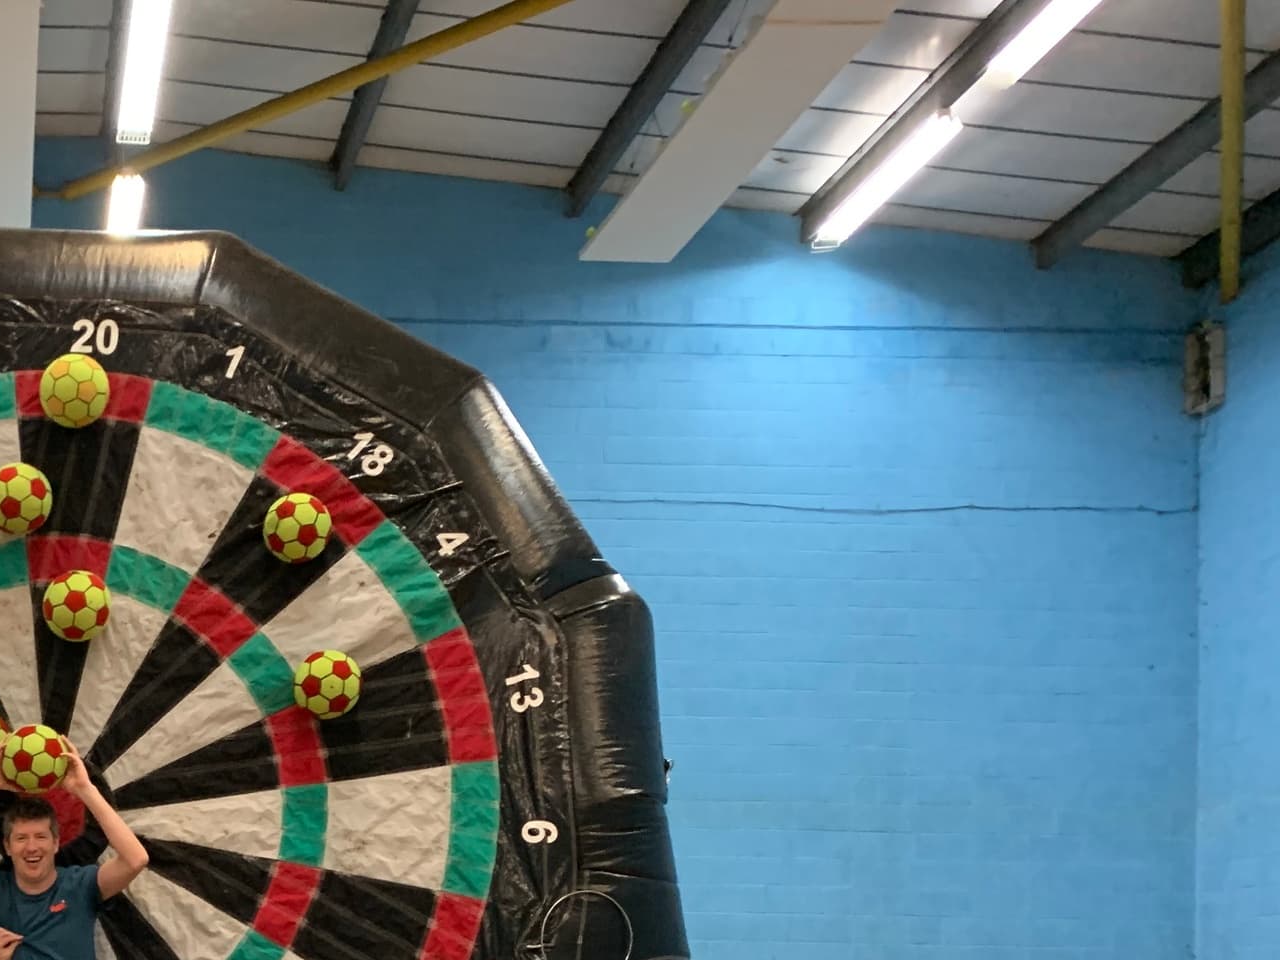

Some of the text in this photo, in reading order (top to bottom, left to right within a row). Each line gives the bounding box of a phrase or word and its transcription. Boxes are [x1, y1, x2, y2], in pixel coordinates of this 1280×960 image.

[69, 318, 119, 355] 20
[224, 345, 245, 379] 1
[346, 431, 394, 477] 18
[435, 531, 470, 558] 4
[505, 663, 544, 713] 13
